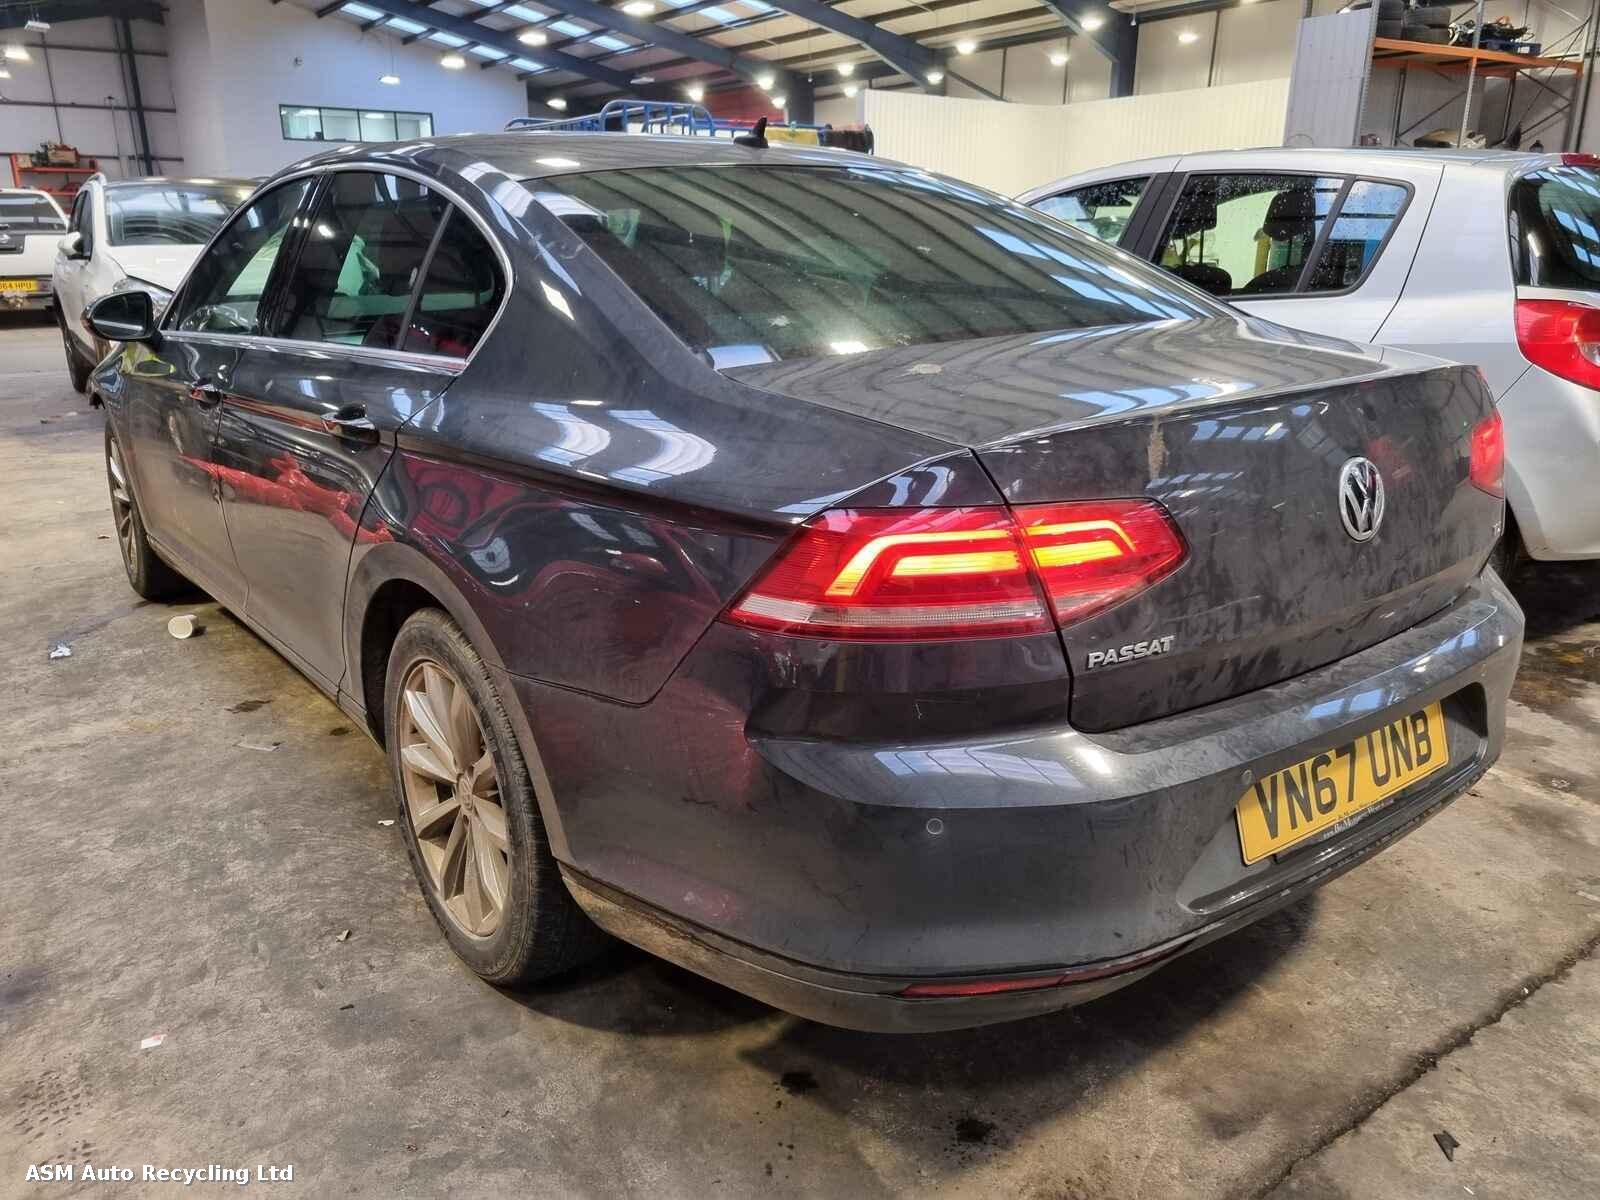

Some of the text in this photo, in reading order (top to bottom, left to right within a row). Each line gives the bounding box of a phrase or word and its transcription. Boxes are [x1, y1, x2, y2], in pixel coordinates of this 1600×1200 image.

[1087, 635, 1176, 669] PASSAT
[1253, 742, 1357, 840] VN67
[1366, 710, 1432, 787] UNB
